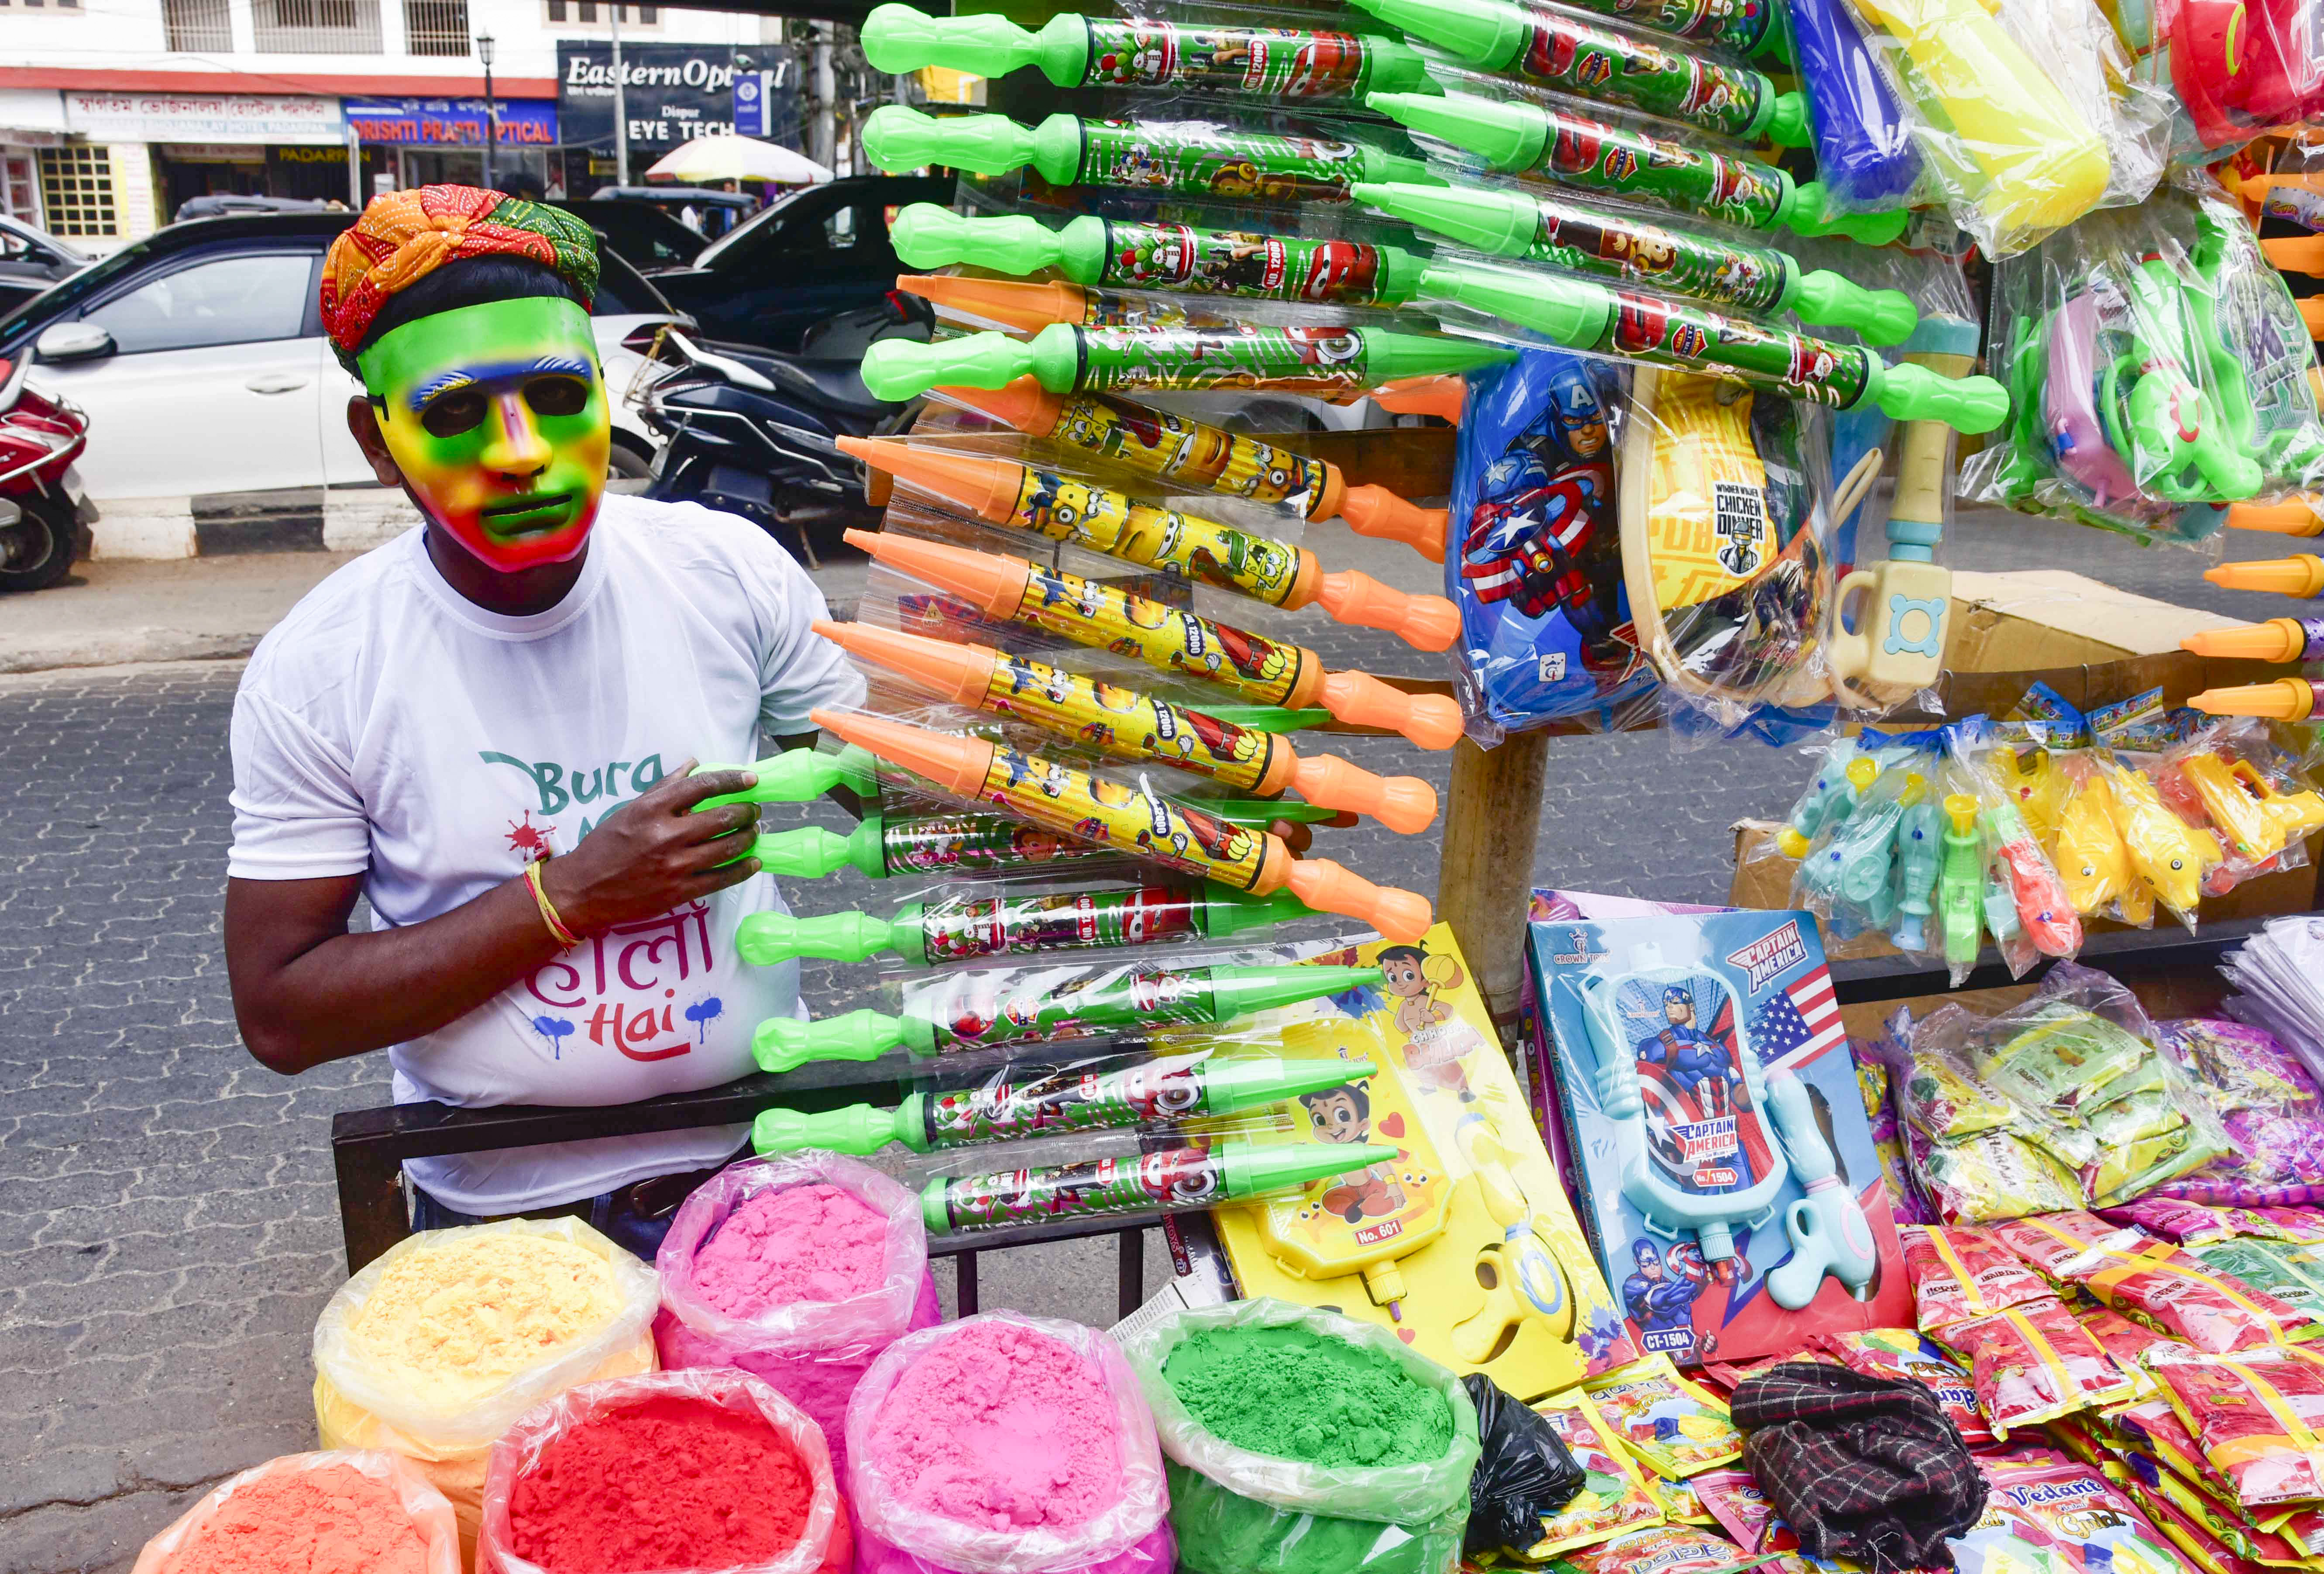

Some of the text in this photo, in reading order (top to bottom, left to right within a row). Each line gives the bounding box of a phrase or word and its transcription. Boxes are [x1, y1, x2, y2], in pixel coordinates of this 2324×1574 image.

[1252, 42, 1265, 73] 12000
[629, 120, 736, 141] EYE TECH
[279, 148, 370, 163] PADARPN
[1268, 241, 1281, 285] NO. 12000
[1571, 384, 1595, 409] A
[1717, 494, 1761, 518] CHICKEN
[1188, 625, 1201, 654] 12000
[2057, 733, 2075, 741] TOYS
[479, 751, 664, 816] Bura
[1554, 953, 1587, 965] CROWN
[1747, 926, 1798, 967] CAPTAIN
[1751, 940, 1804, 994] AMERICA
[584, 988, 691, 1062] Hai
[1411, 1022, 1465, 1044] CHHOTA
[1685, 1119, 1734, 1140] CAPTAIN
[1685, 1133, 1736, 1161] AMERICA
[1696, 1171, 1733, 1183] No. 1504
[1165, 1223, 1179, 1253] TOYS
[1357, 1221, 1400, 1244] No. 601
[1645, 1333, 1690, 1351] CT-1504
[2005, 1478, 2103, 1506] Vedant
[2056, 1509, 2127, 1539] Gulal
